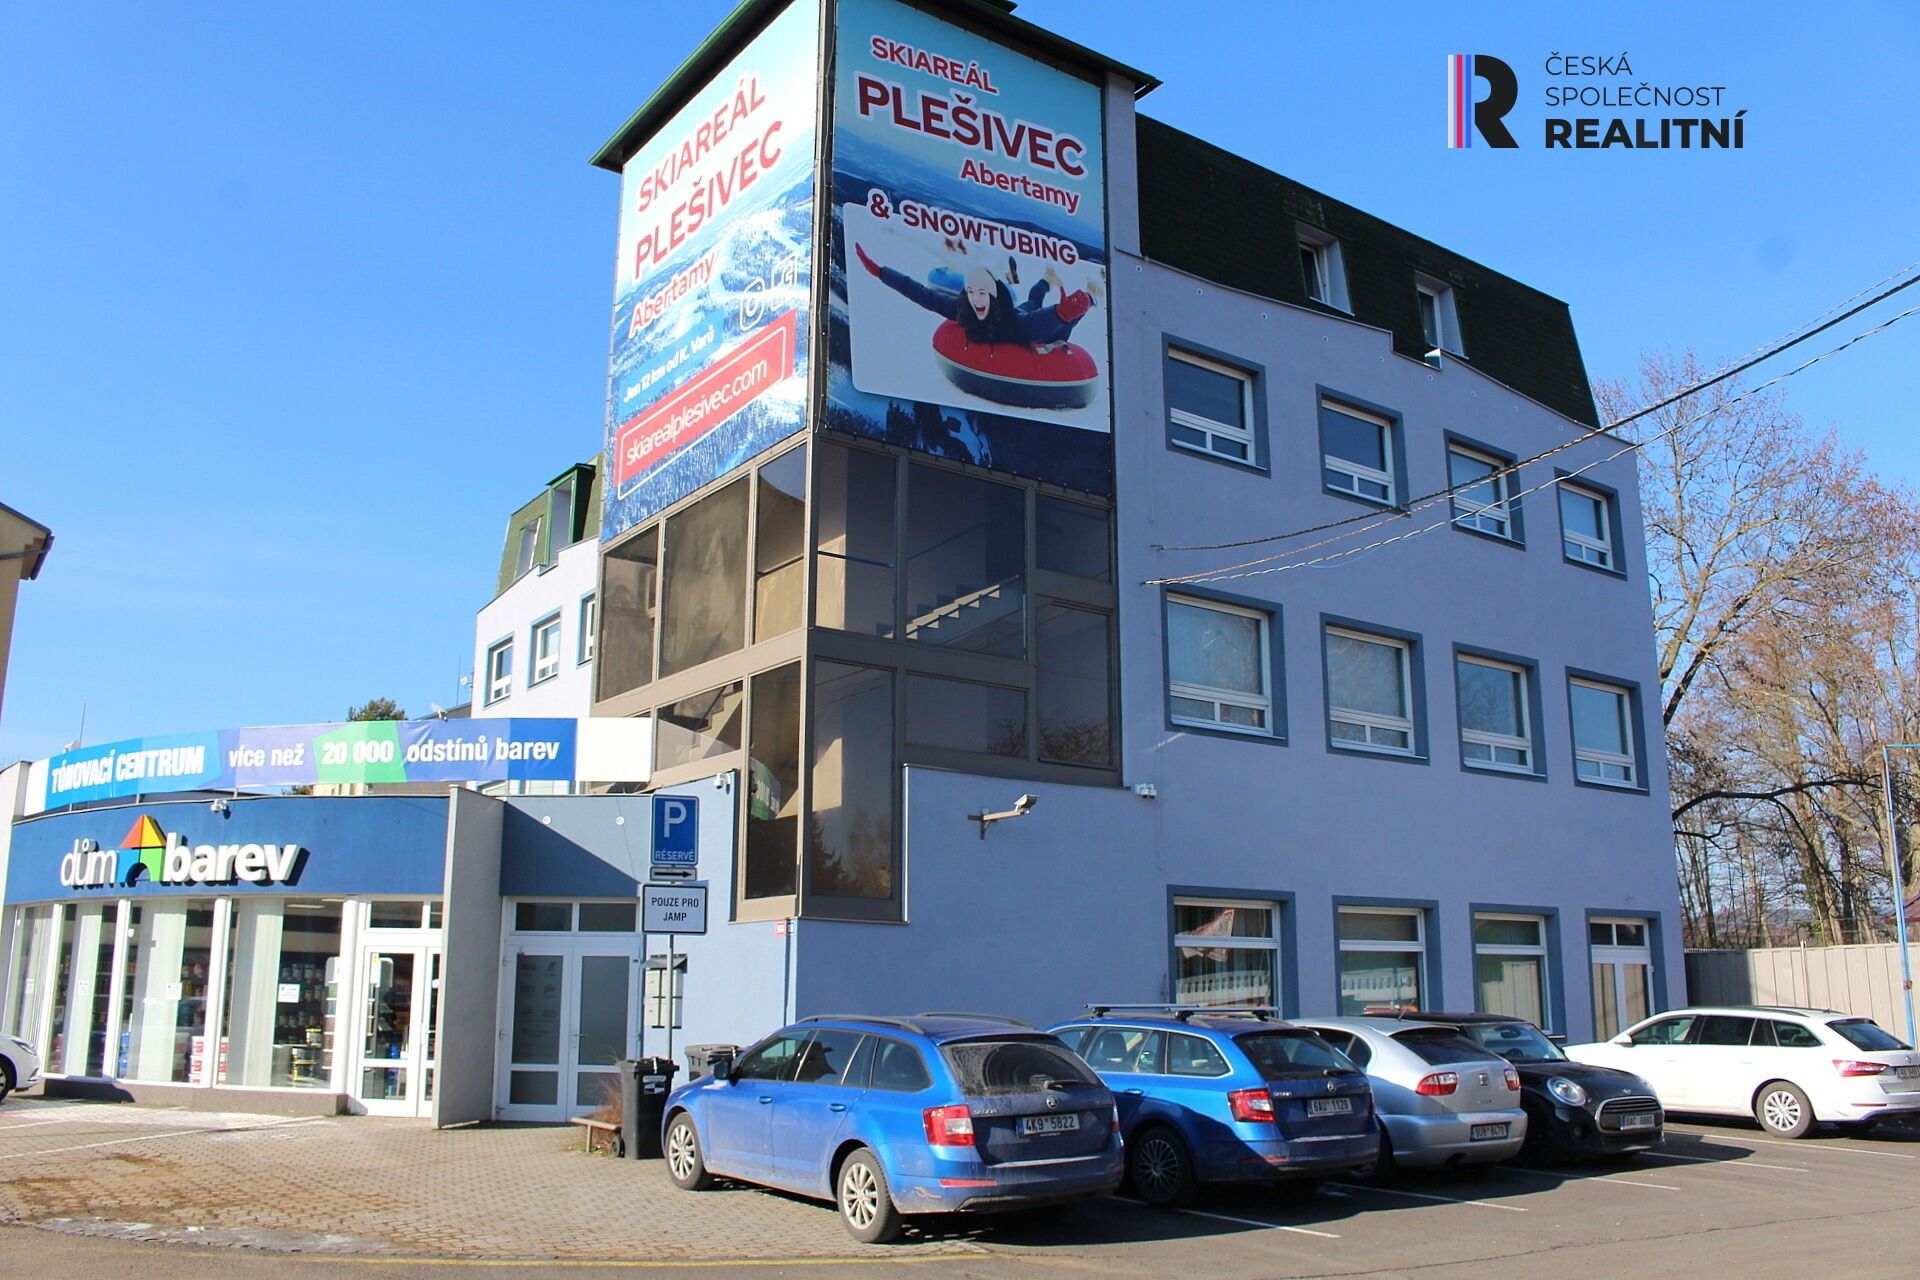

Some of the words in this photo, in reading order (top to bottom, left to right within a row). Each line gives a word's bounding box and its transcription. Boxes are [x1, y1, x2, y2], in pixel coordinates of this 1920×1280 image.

[872, 37, 998, 94] SKIAREÁL
[638, 77, 766, 213] SKIAREÁL
[858, 76, 1085, 177] PLEŠIVEC
[635, 120, 783, 280] PLEŠIVEC
[960, 159, 1080, 215] Abertamy
[870, 193, 890, 219] &
[902, 204, 1077, 265] SNOWTUBING
[631, 251, 716, 335] Abertamy
[651, 365, 666, 385] km
[665, 351, 680, 373] od
[626, 359, 768, 466] skiarealplesivec.com
[51, 749, 116, 794] TÓNOVACÍ
[116, 745, 205, 782] CENTRUM
[229, 745, 265, 768] více
[271, 743, 305, 767] než
[321, 741, 348, 765] 20
[353, 740, 394, 764] 000
[407, 735, 488, 763] odstínů
[495, 737, 561, 761] barev
[664, 801, 687, 838] P
[60, 838, 118, 887] dům
[162, 832, 299, 883] barev
[655, 848, 695, 861] RÉSERVÉ
[651, 897, 679, 907] POUZE
[682, 898, 699, 907] PRO
[663, 912, 687, 921] JAMP
[1025, 1118, 1043, 1131] 4K9
[1050, 1115, 1075, 1129] 5822
